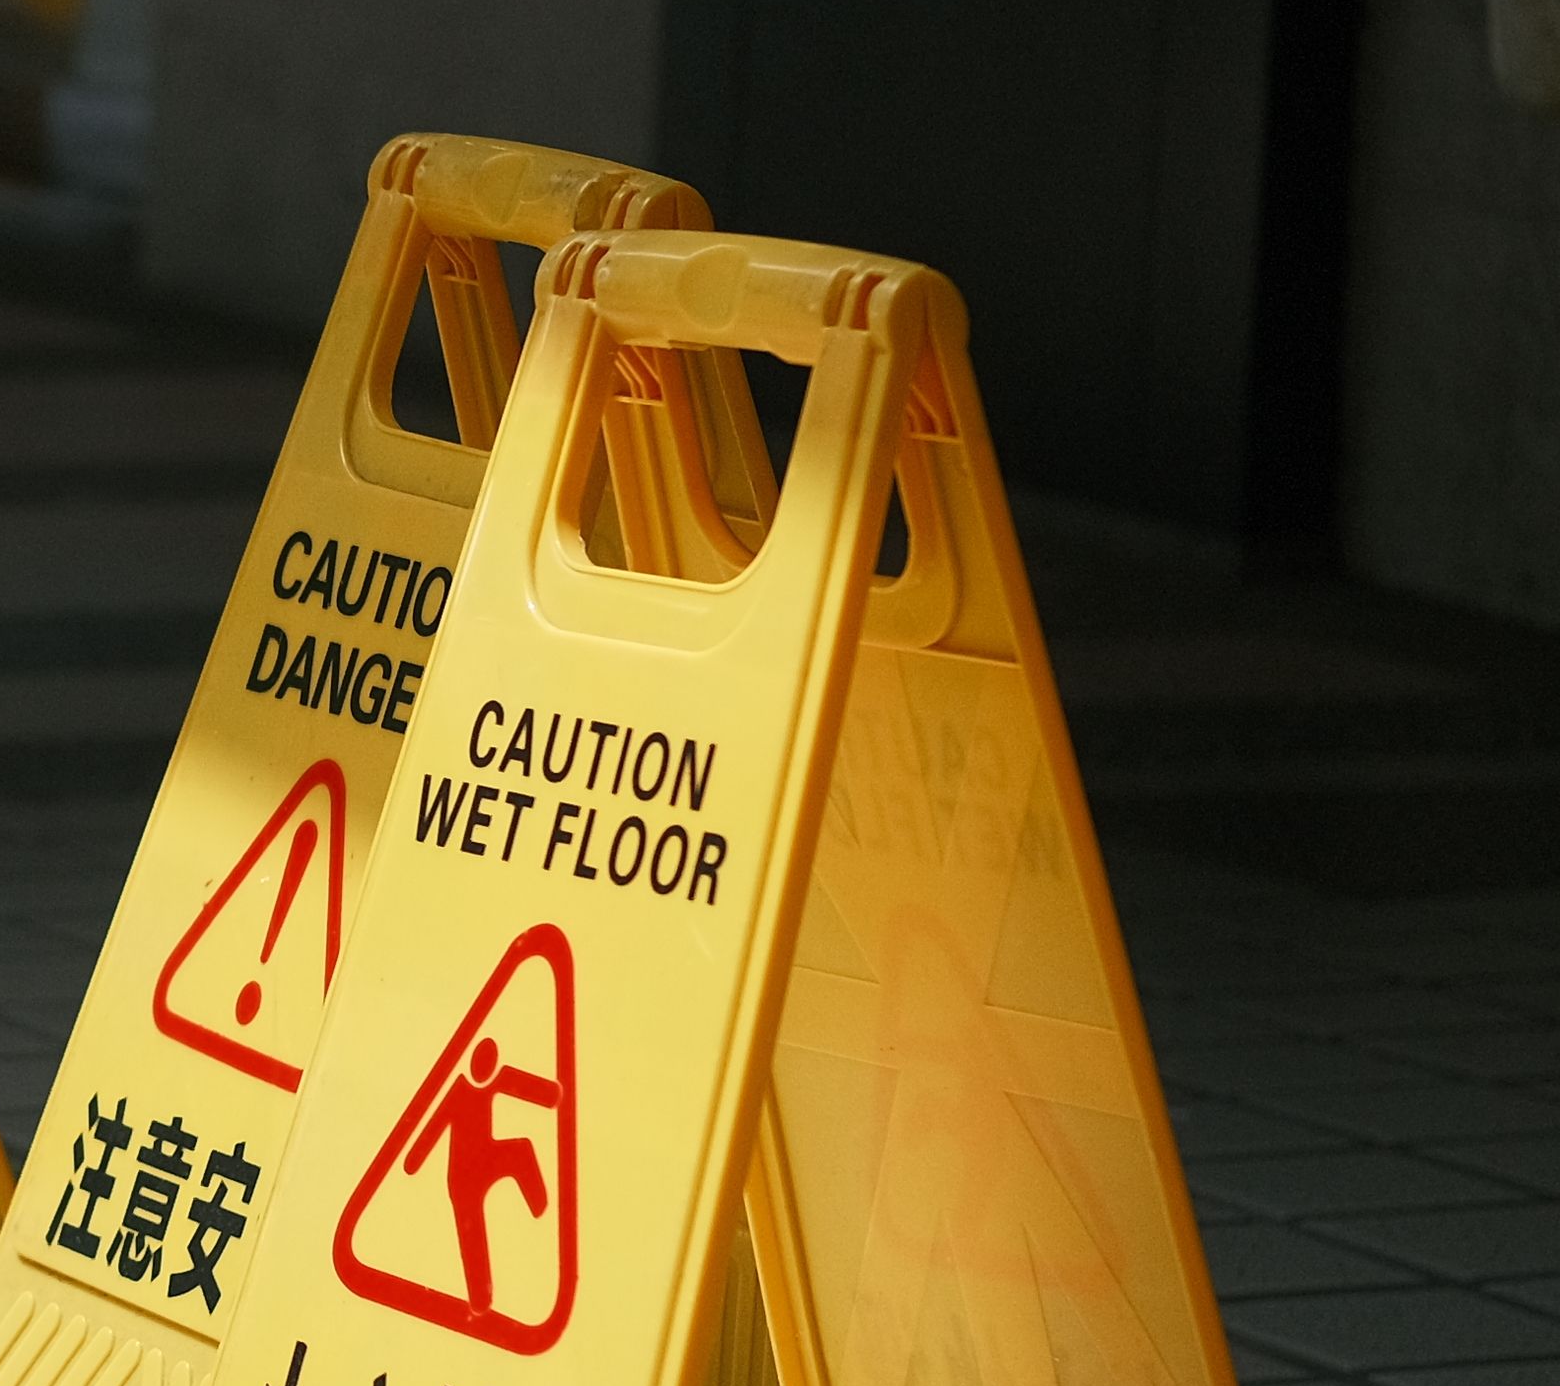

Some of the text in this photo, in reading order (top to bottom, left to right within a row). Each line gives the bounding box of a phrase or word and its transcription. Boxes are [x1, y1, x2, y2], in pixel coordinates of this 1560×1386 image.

[272, 530, 454, 637] CAUTIO
[245, 622, 426, 735] DANGE
[468, 699, 717, 812] CAUTION
[415, 773, 535, 862] WET
[542, 800, 729, 907] FLOOR
[45, 1092, 262, 1315] 注意安
